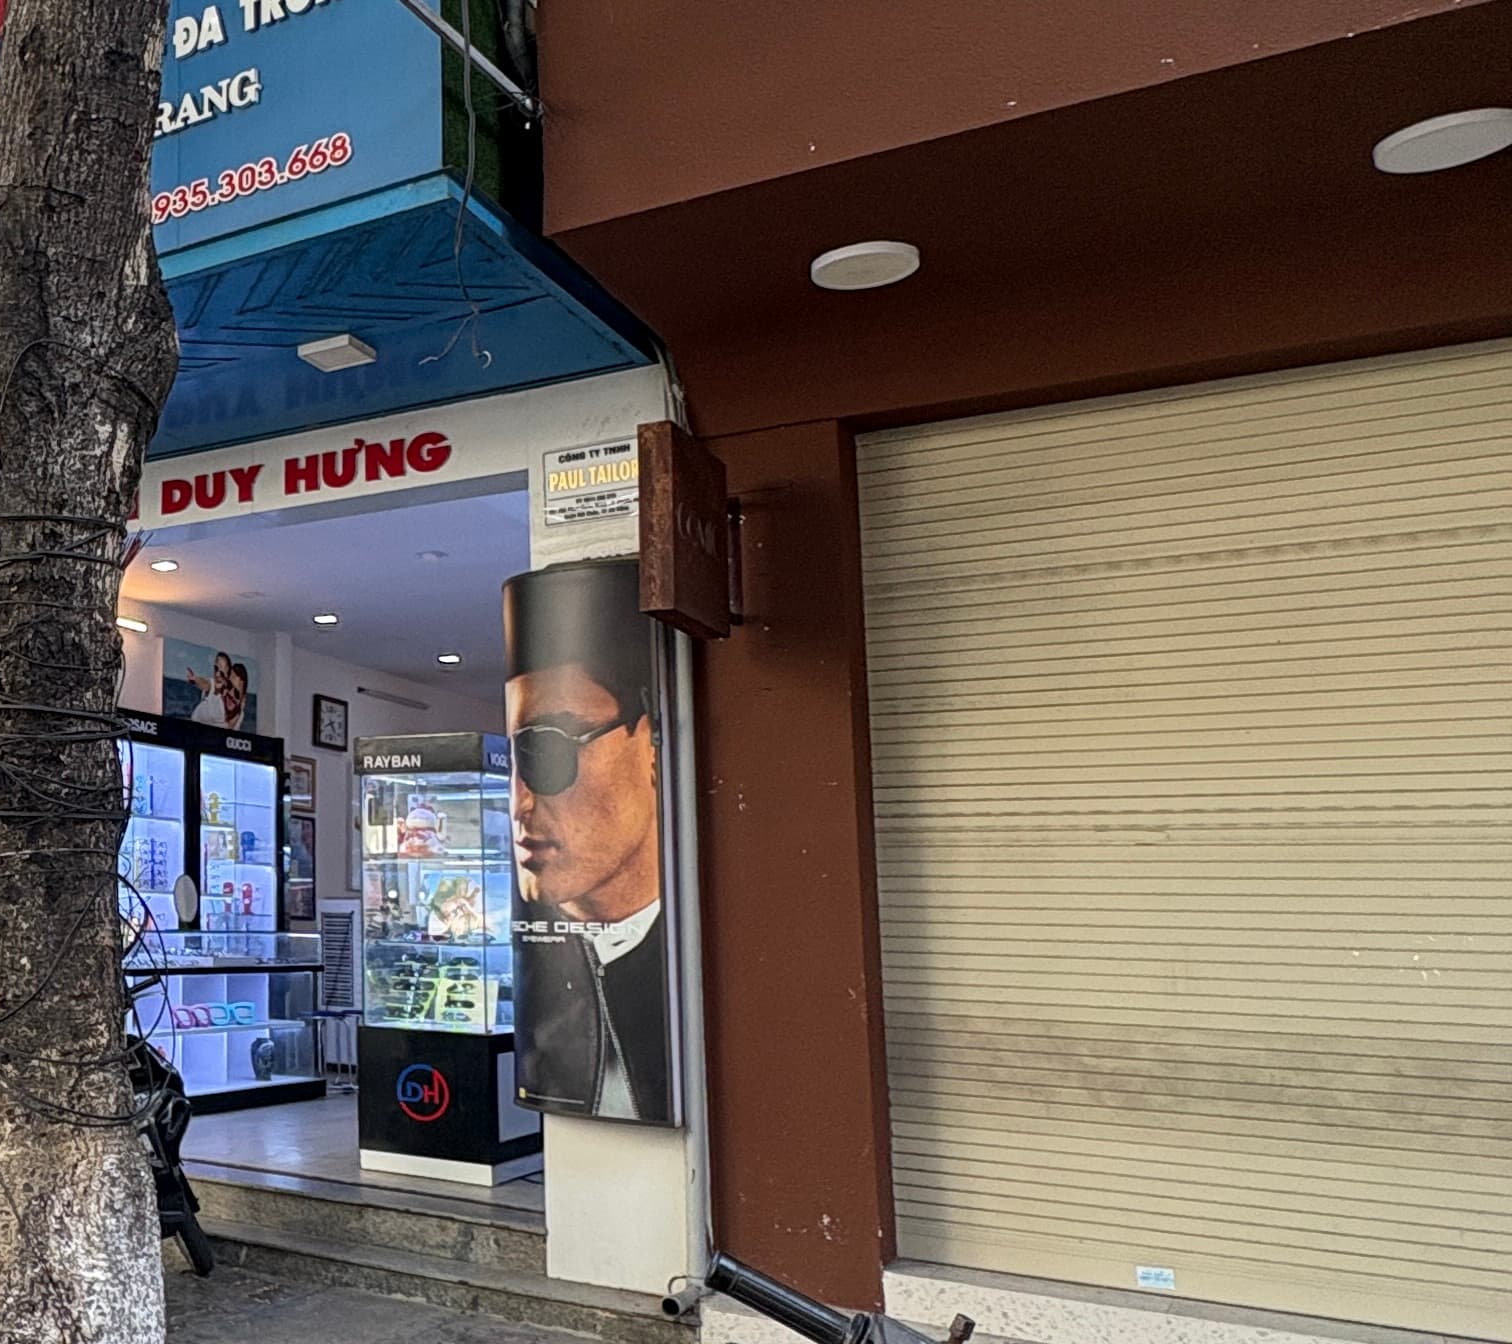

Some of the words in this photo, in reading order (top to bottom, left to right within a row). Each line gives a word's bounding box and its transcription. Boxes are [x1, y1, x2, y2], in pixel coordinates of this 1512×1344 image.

[173, 5, 224, 59] ĐA
[153, 68, 263, 137] RANG
[151, 132, 352, 224] 935.303.668
[161, 464, 262, 515] DUY
[284, 432, 453, 495] HƯNG
[589, 449, 601, 459] TY
[549, 468, 587, 492] PAUL
[226, 736, 252, 752] GUCCI
[363, 754, 421, 769] RAYBAN
